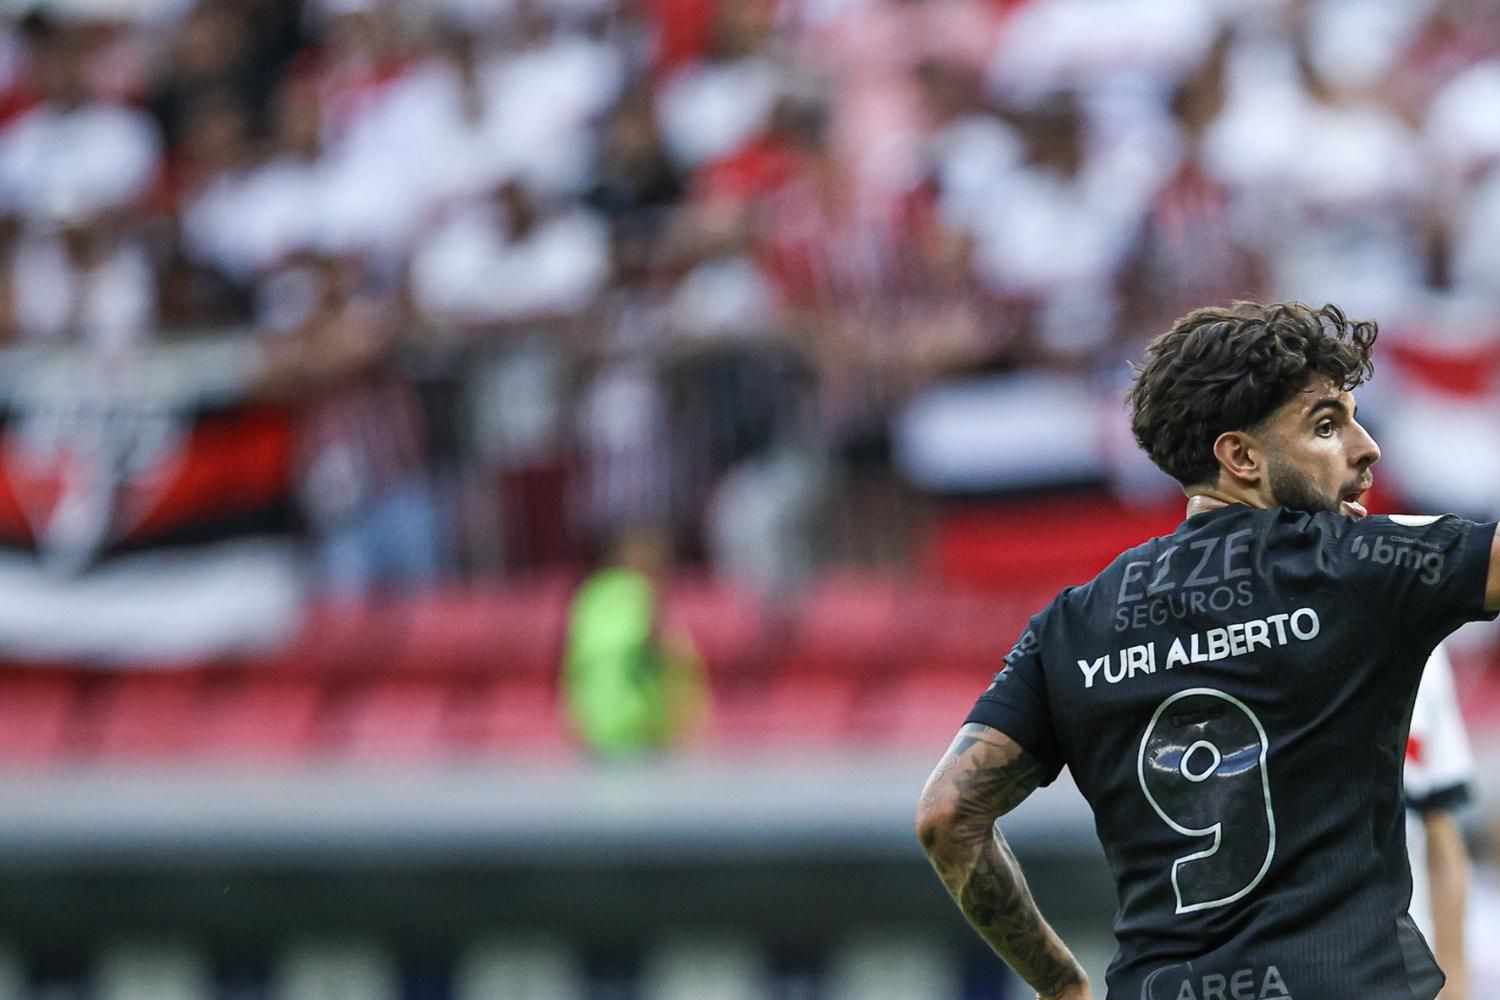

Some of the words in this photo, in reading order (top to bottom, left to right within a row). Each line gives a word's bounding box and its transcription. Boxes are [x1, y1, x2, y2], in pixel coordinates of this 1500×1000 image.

[1371, 535, 1445, 585] bmg
[1114, 581, 1254, 632] SEGUROS
[1077, 642, 1156, 688] YURI
[1165, 607, 1320, 670] ALBERTO
[1138, 688, 1277, 914] 9
